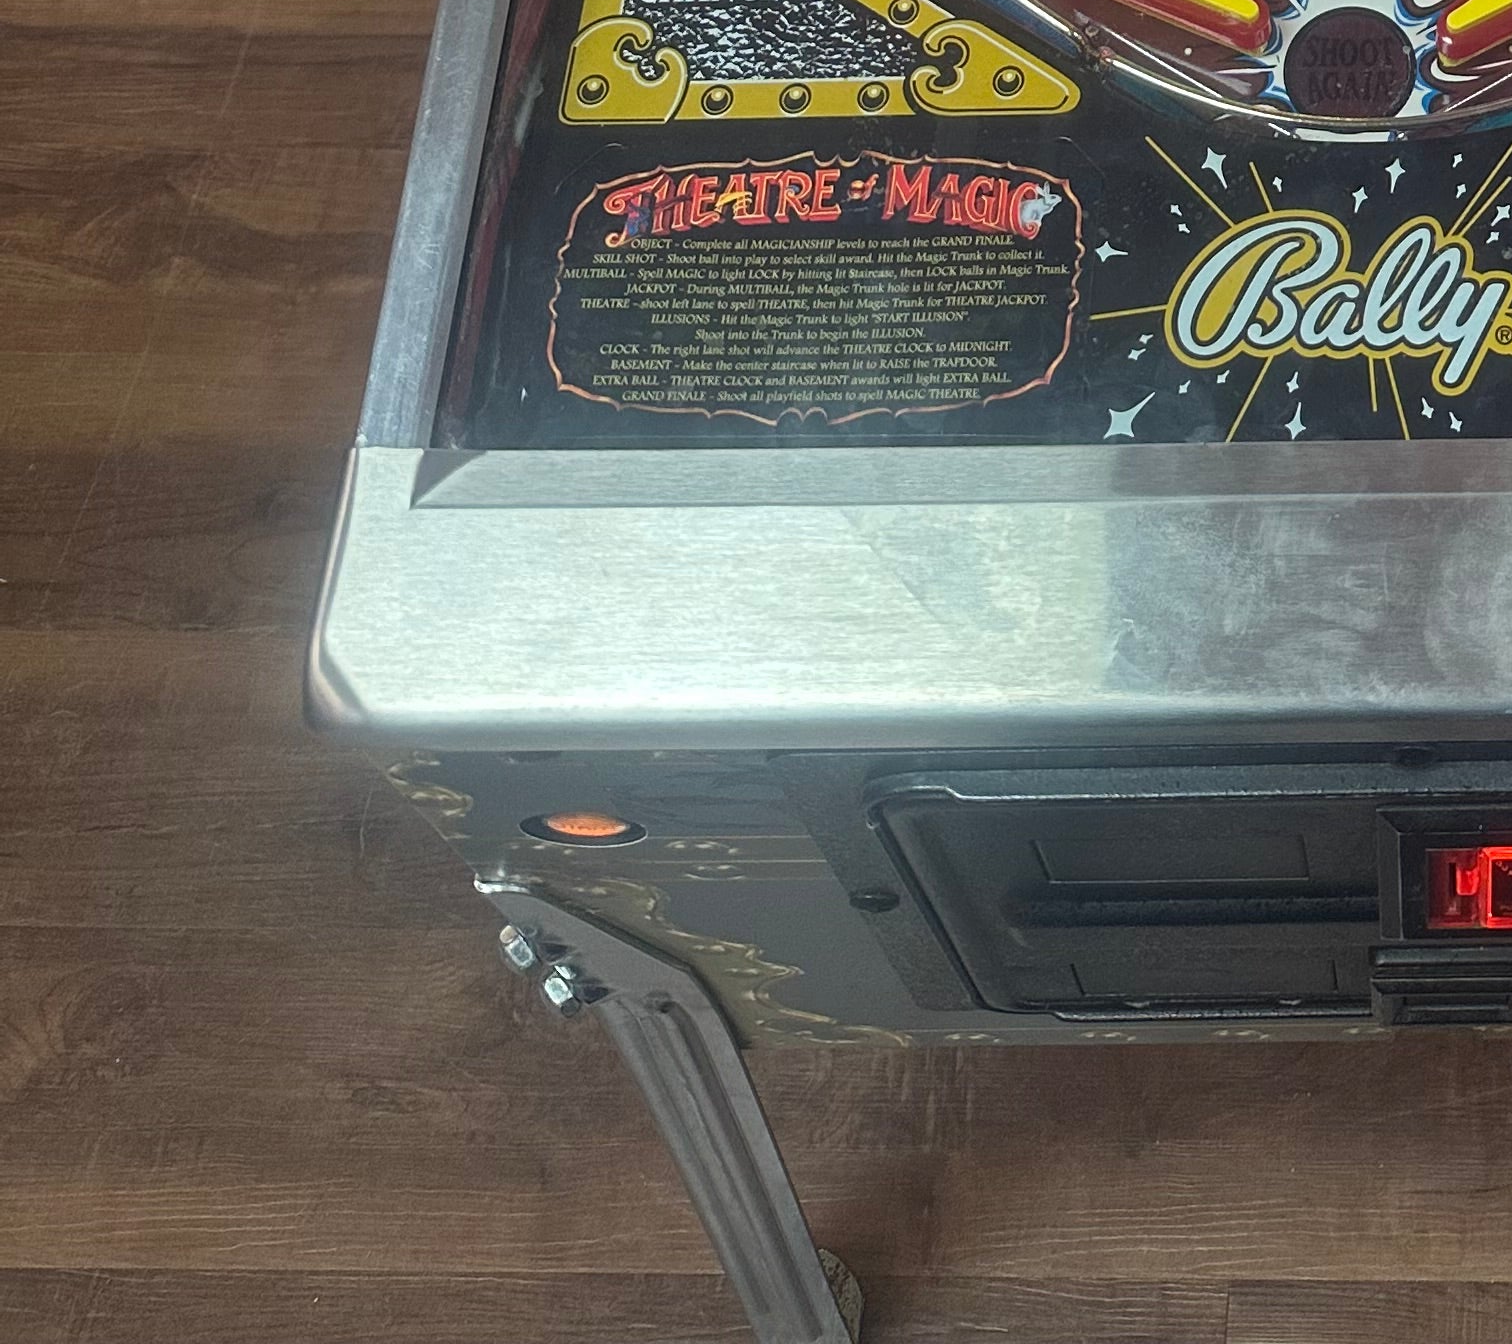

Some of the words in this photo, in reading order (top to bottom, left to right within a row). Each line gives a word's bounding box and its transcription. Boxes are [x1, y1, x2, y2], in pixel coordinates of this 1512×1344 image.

[603, 167, 842, 248] THEATRE
[882, 163, 1042, 239] MAGIC
[631, 239, 673, 250] OBJECT
[682, 238, 732, 249] Complete
[734, 238, 748, 249] all
[749, 237, 835, 249] MAGICIANSHIP
[836, 237, 865, 248] levels
[868, 236, 878, 248] to
[880, 236, 909, 247] reach
[912, 236, 929, 247] the
[931, 235, 972, 247] GRAND
[974, 235, 1013, 246] FINALE.
[1172, 215, 1508, 389] Bally
[696, 330, 724, 340] Shoot
[727, 330, 749, 340] into
[750, 329, 768, 340] the
[770, 329, 803, 339] Trunk
[806, 329, 817, 339] to
[819, 329, 848, 339] begin
[851, 329, 868, 339] the
[870, 328, 926, 338] ILLUSION.
